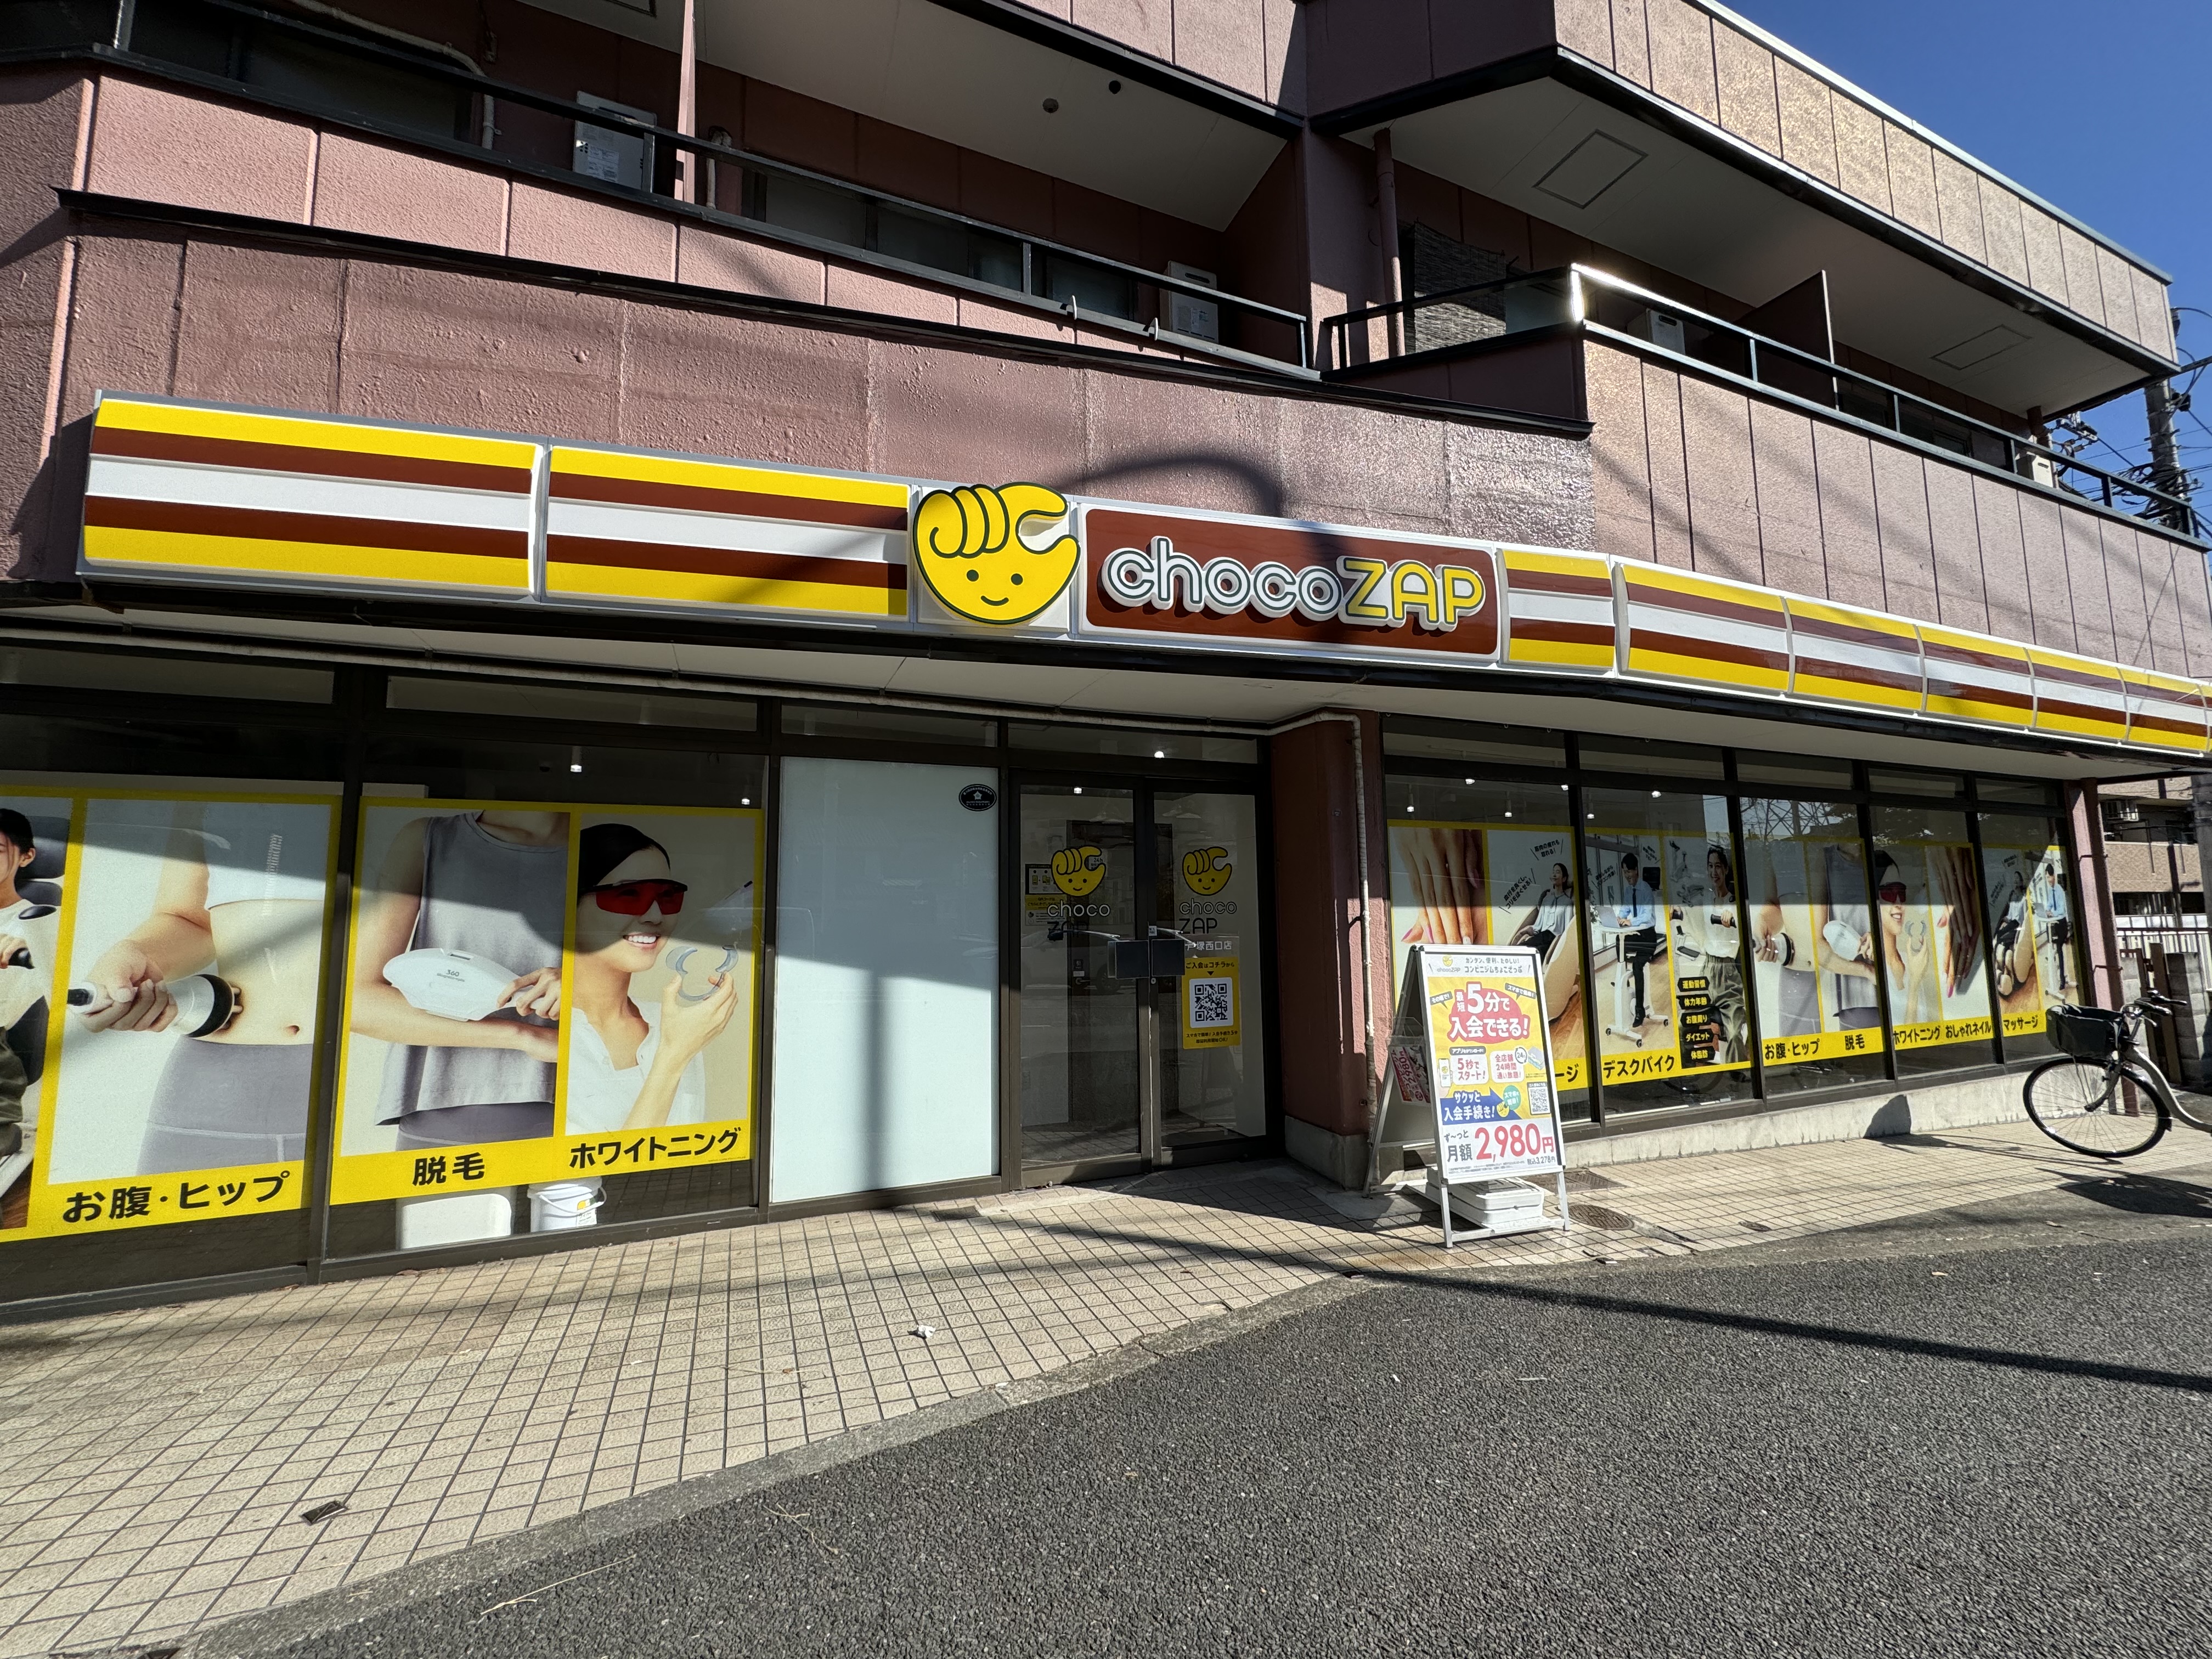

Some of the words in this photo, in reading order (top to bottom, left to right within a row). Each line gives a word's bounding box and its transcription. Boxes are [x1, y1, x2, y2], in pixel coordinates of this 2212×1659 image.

[1102, 535, 1486, 632] chocoZAP
[1047, 899, 1110, 917] choco
[1180, 898, 1237, 915] choco
[1179, 918, 1217, 934] ZAP
[1449, 1015, 1528, 1038] 入会できる!
[2004, 1015, 2038, 1031] マッサージ
[1685, 1032, 1710, 1042] ダイエット
[1893, 1025, 1940, 1045] ホワイトニング
[1945, 1020, 1991, 1039] おしゃれネイル
[1844, 1034, 1865, 1051] 脱毛
[1458, 1058, 1479, 1070] 5秒で
[1603, 1054, 1675, 1079] デスクバイク
[1458, 1070, 1485, 1081] スタート!
[1454, 1091, 1481, 1103] サクッと
[1444, 1105, 1495, 1122] 入会手続き!
[569, 1127, 741, 1169] ホワイトニング
[1447, 1144, 1472, 1162] 月額
[413, 1152, 485, 1186] 脱毛
